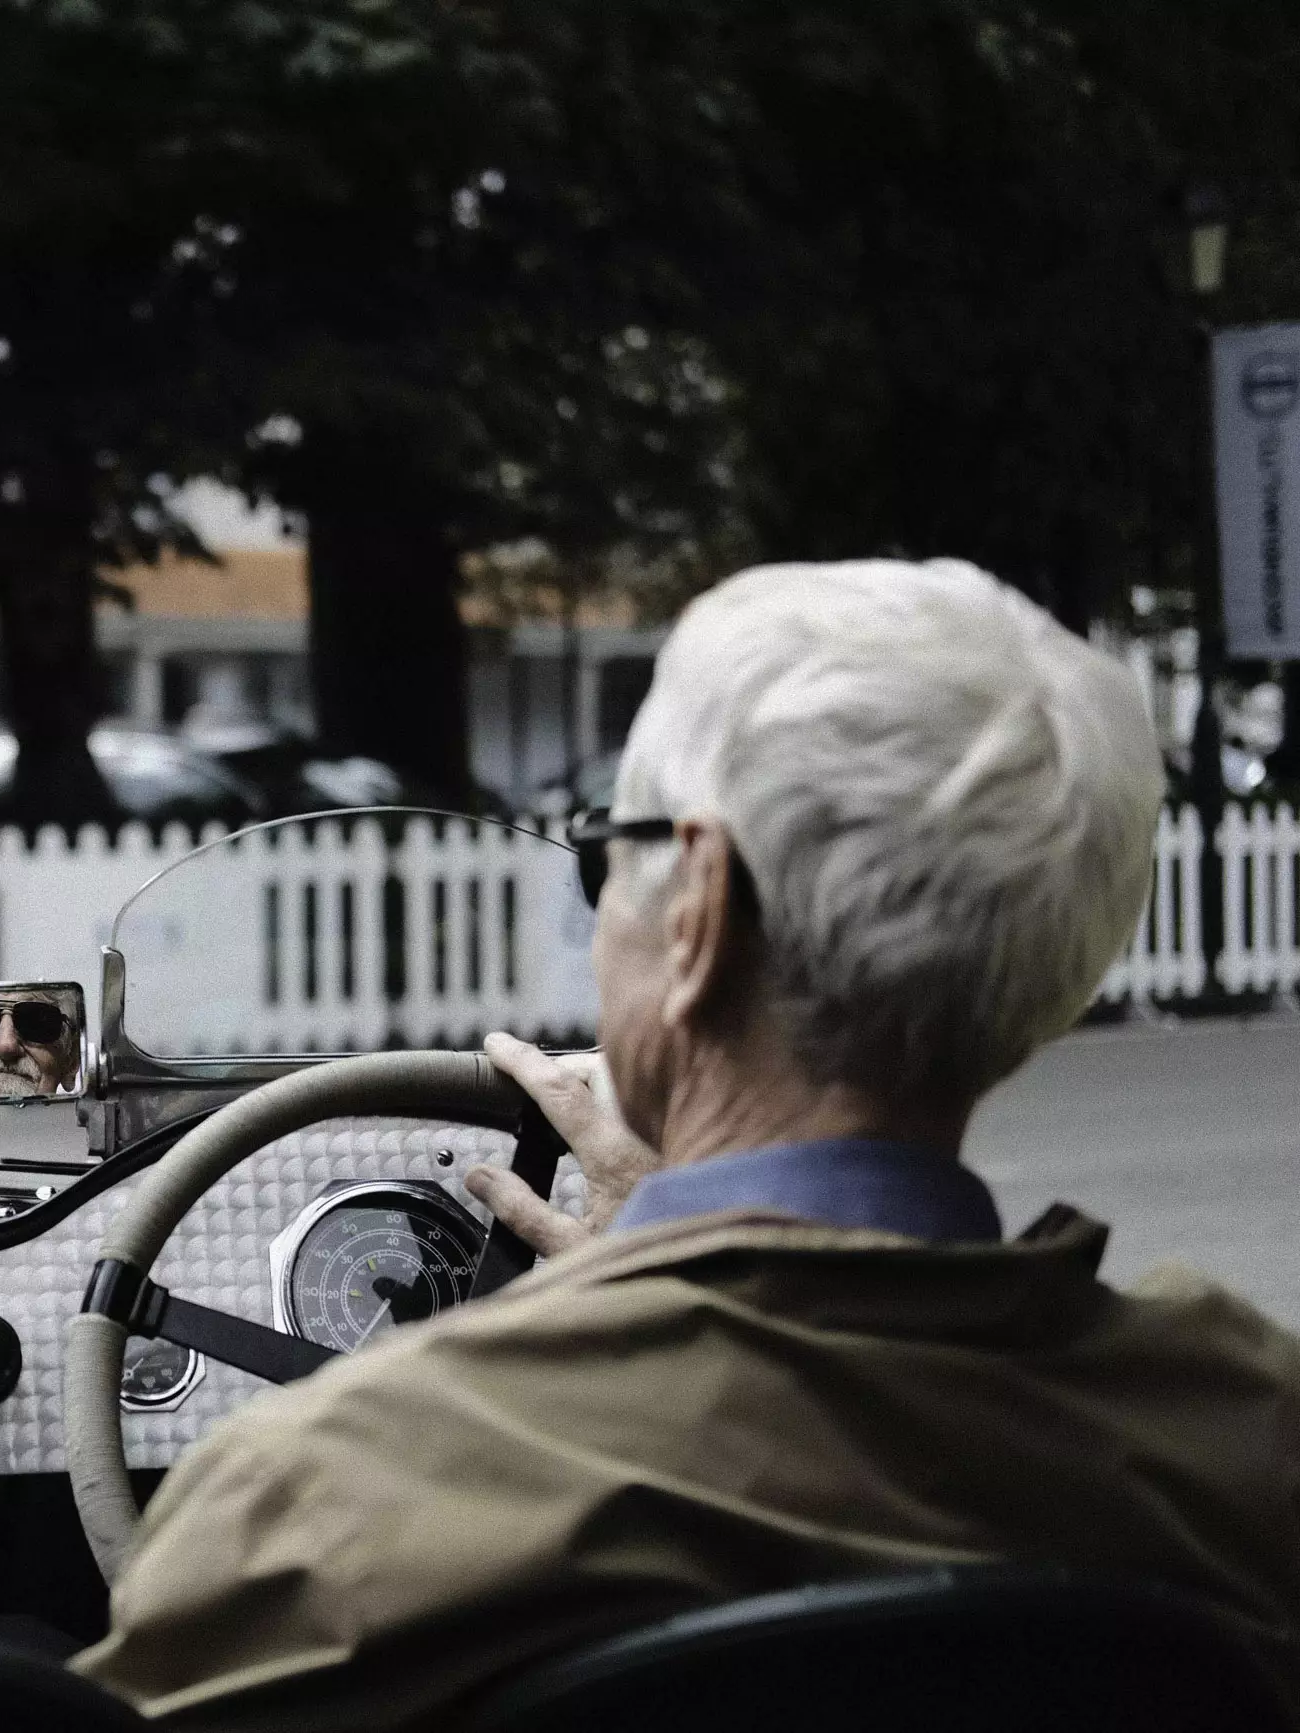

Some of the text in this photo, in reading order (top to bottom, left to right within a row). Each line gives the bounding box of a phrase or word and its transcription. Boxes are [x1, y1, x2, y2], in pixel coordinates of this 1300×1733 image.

[386, 1214, 402, 1224] 60
[428, 1230, 441, 1240] 70
[386, 1237, 399, 1246] 40
[341, 1254, 353, 1264] 30
[429, 1264, 442, 1273] 50
[453, 1266, 468, 1276] 80
[304, 1287, 318, 1297] 30
[327, 1290, 339, 1300] 20
[310, 1316, 324, 1327] 20
[337, 1322, 347, 1331] 10
